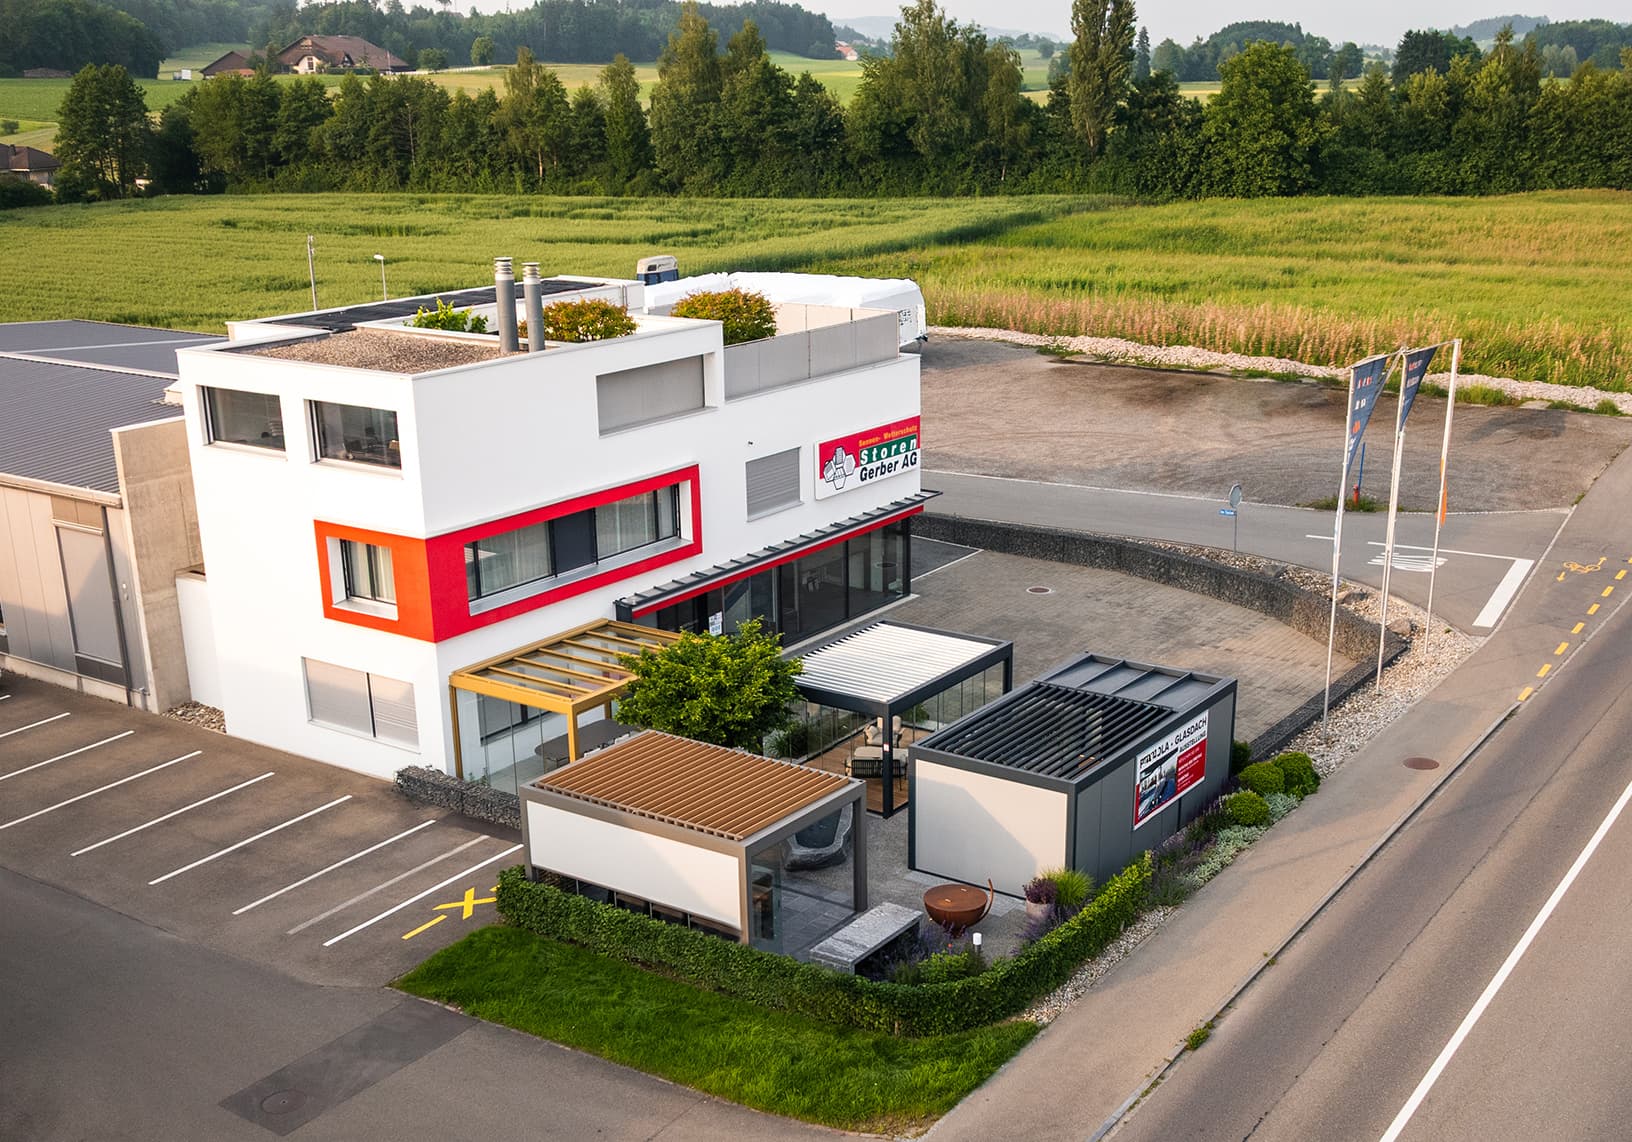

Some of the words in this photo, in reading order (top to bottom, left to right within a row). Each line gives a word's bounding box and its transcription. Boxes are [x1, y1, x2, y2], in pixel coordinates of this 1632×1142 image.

[860, 438, 917, 466] Storen
[860, 460, 899, 482] Gerber
[902, 452, 917, 469] AG
[1174, 716, 1207, 745] GLASDACH
